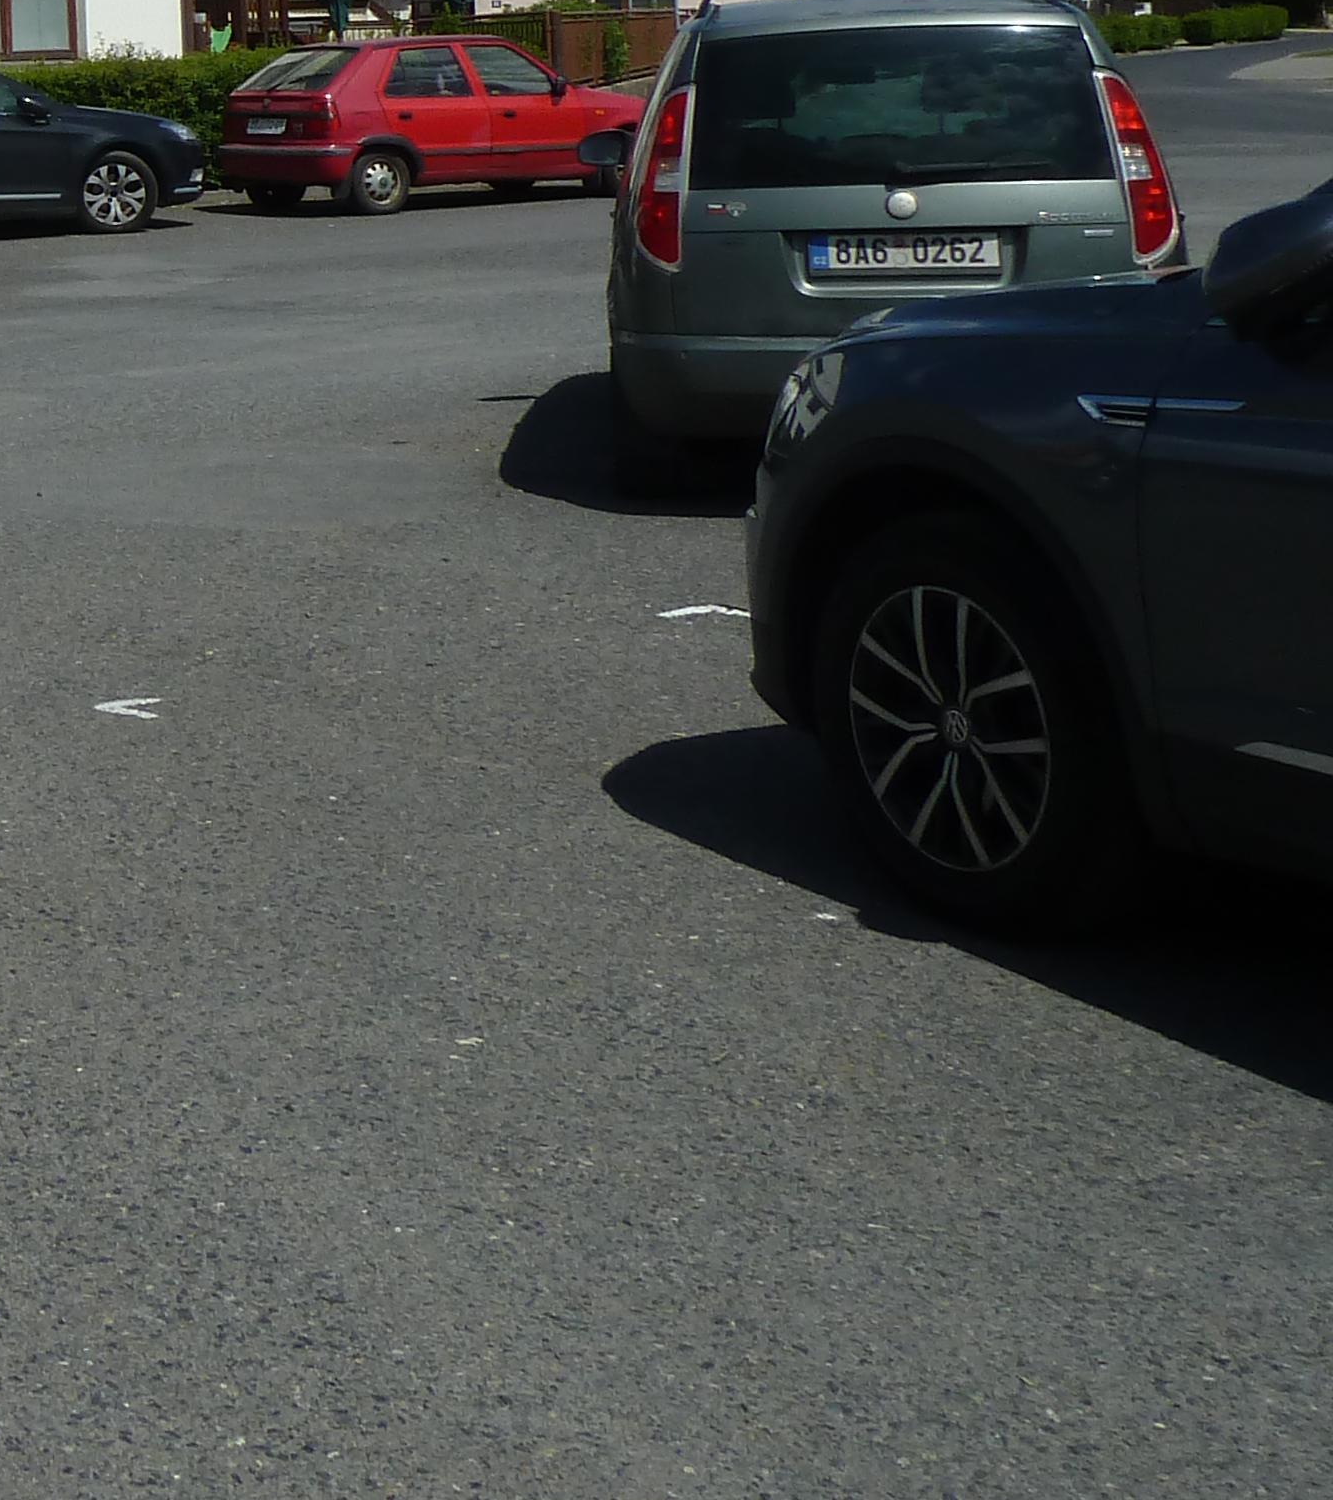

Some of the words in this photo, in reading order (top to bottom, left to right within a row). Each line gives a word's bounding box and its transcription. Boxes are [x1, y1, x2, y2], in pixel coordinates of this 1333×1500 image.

[836, 238, 888, 264] 8A6
[913, 236, 984, 263] 0262
[813, 255, 827, 265] CZ
